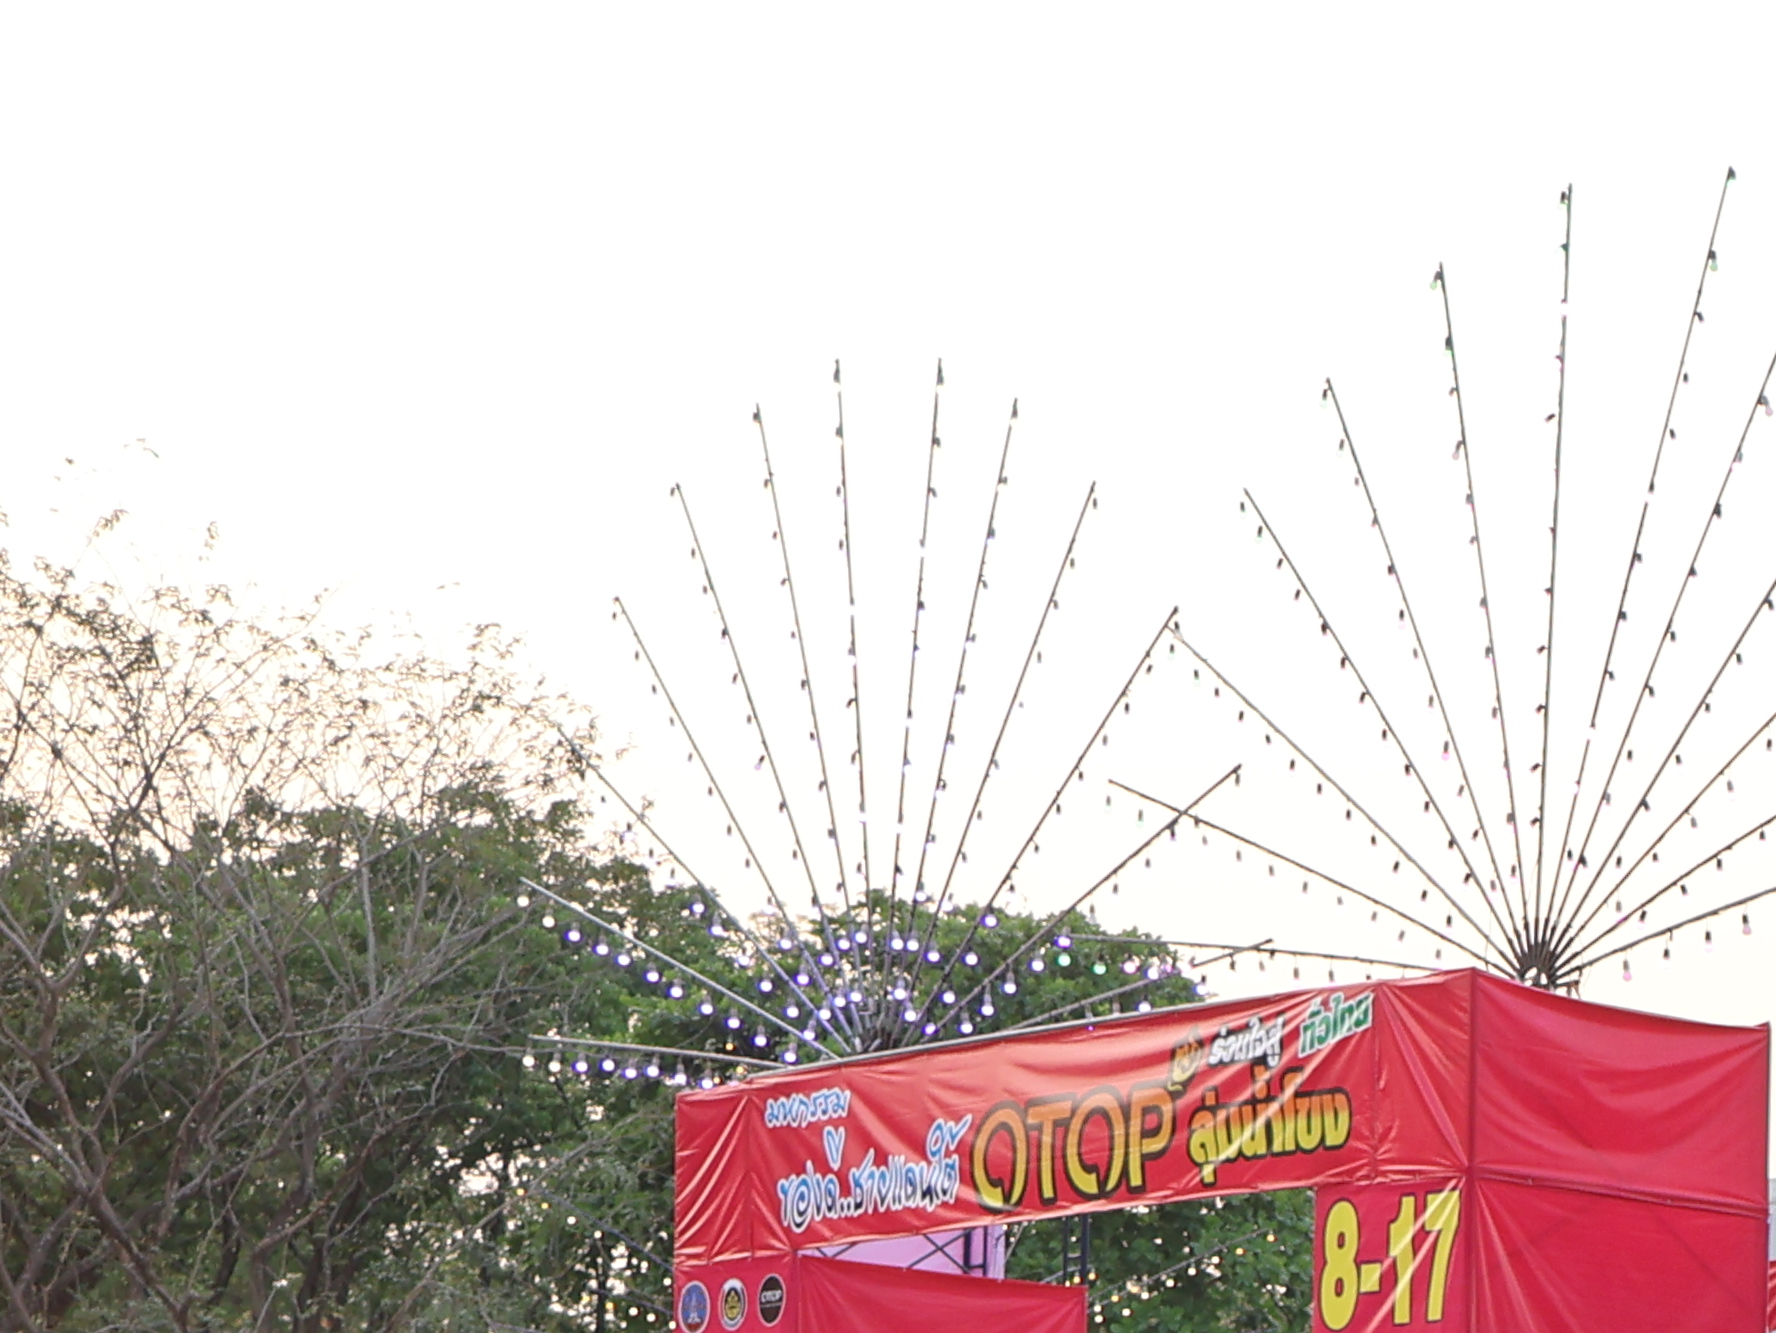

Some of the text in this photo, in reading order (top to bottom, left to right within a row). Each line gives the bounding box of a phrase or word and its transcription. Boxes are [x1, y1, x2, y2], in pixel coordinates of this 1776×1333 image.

[1298, 990, 1374, 1058] ทั่วไทย
[764, 1087, 851, 1128] มหกรรม
[971, 1064, 1352, 1212] OTOP ลุ่มน้ำโขง
[1320, 1189, 1461, 1332] 8-17
